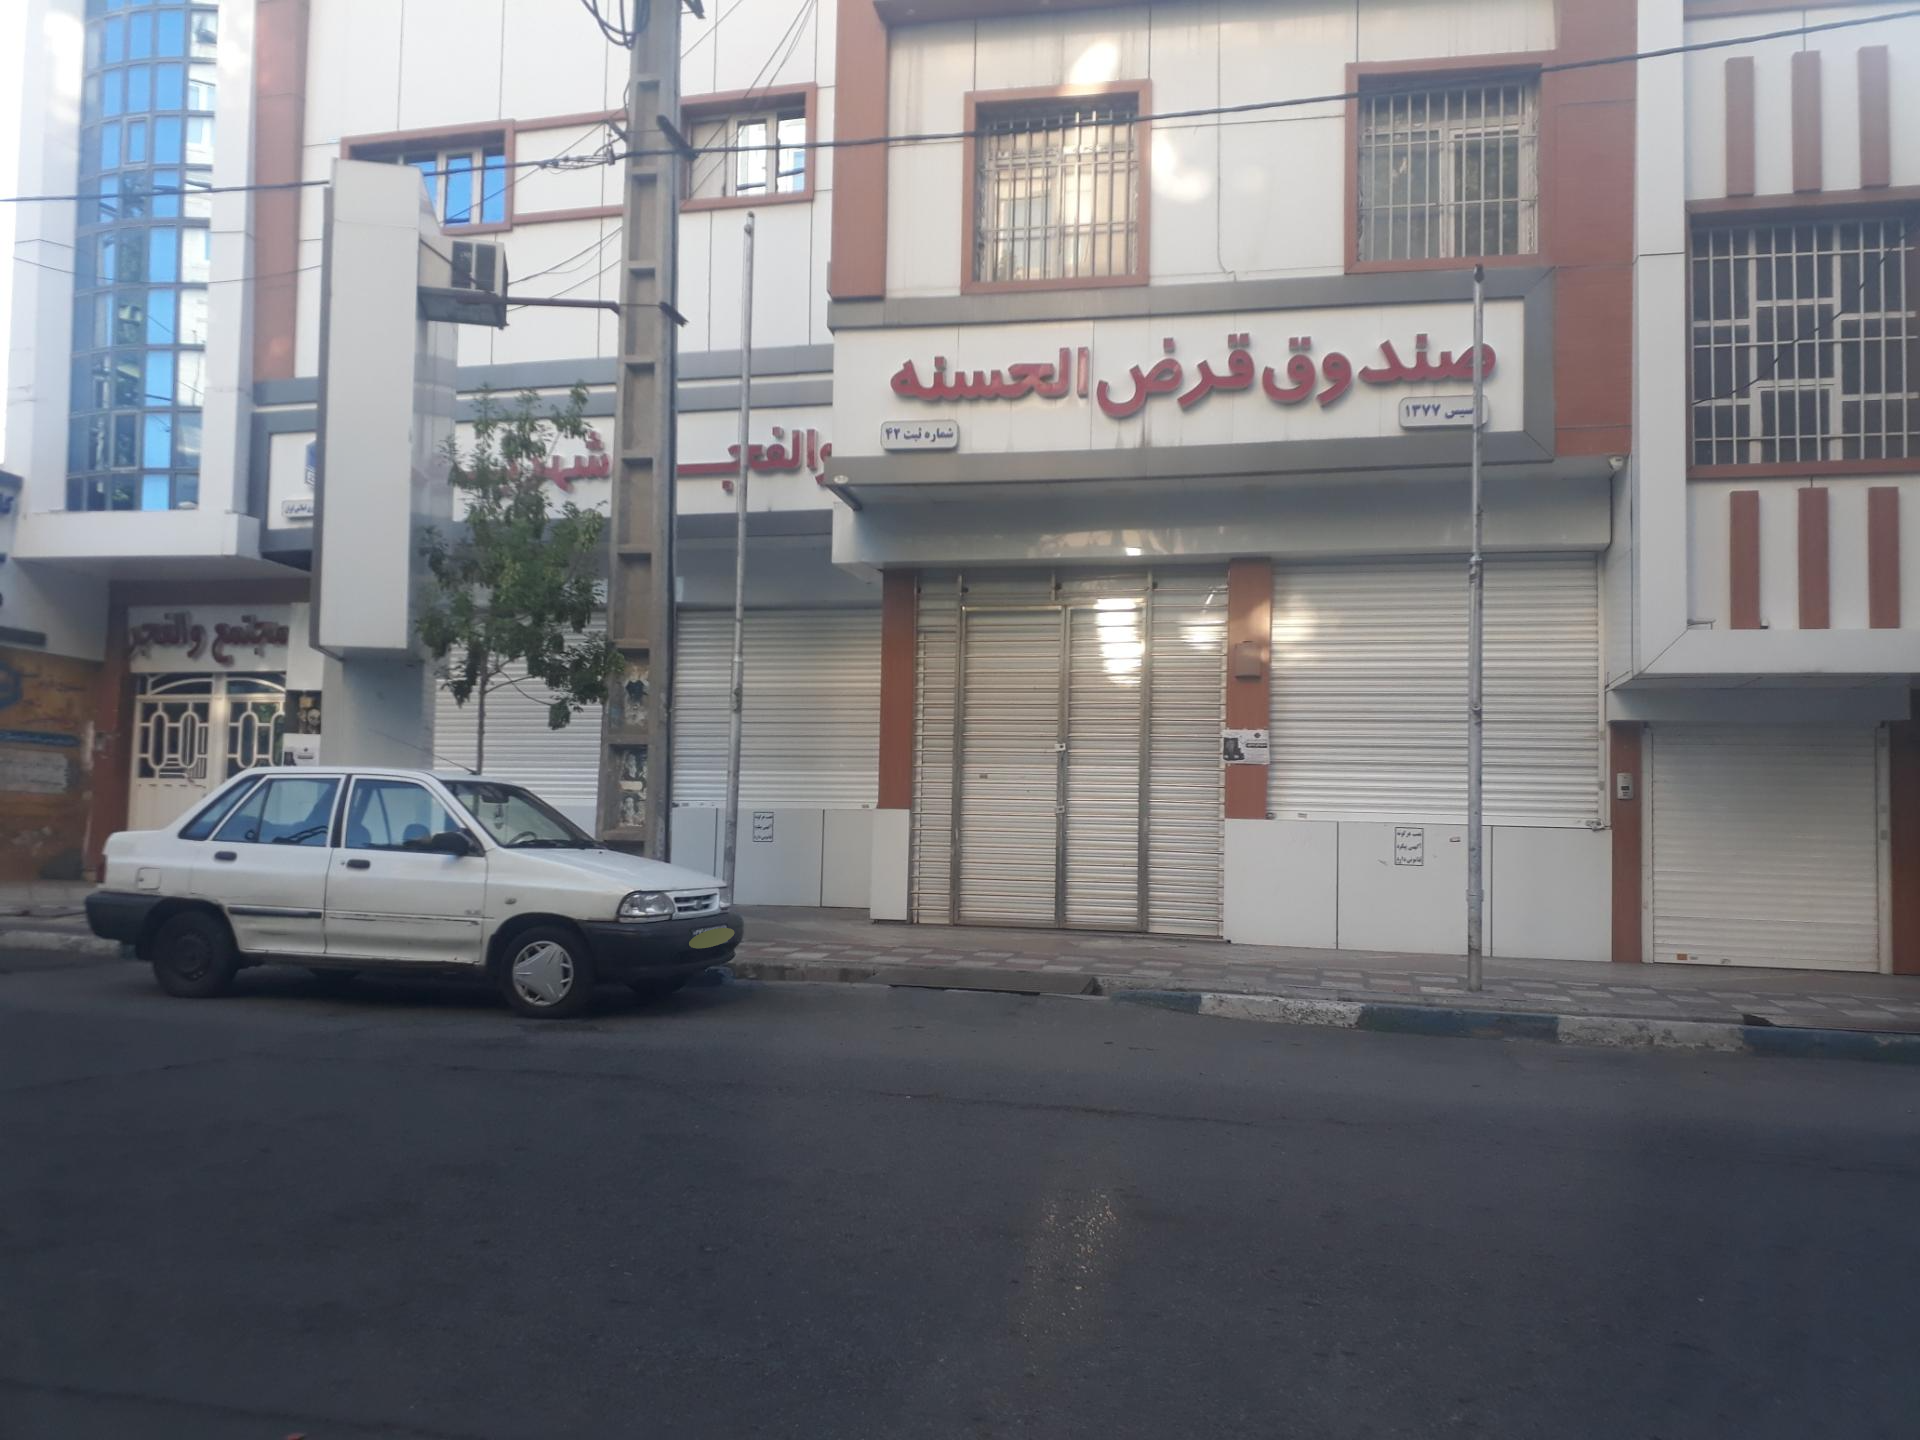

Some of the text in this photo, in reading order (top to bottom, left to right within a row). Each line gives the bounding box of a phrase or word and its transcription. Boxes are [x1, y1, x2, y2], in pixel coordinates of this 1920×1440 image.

[889, 332, 1497, 419] صندوق قرض الحسنه
[1406, 404, 1474, 419] سیس ۱۳۷۷
[904, 426, 922, 442] ثبت
[924, 427, 954, 442] شماره
[130, 611, 289, 666] مجتمع والفجر
